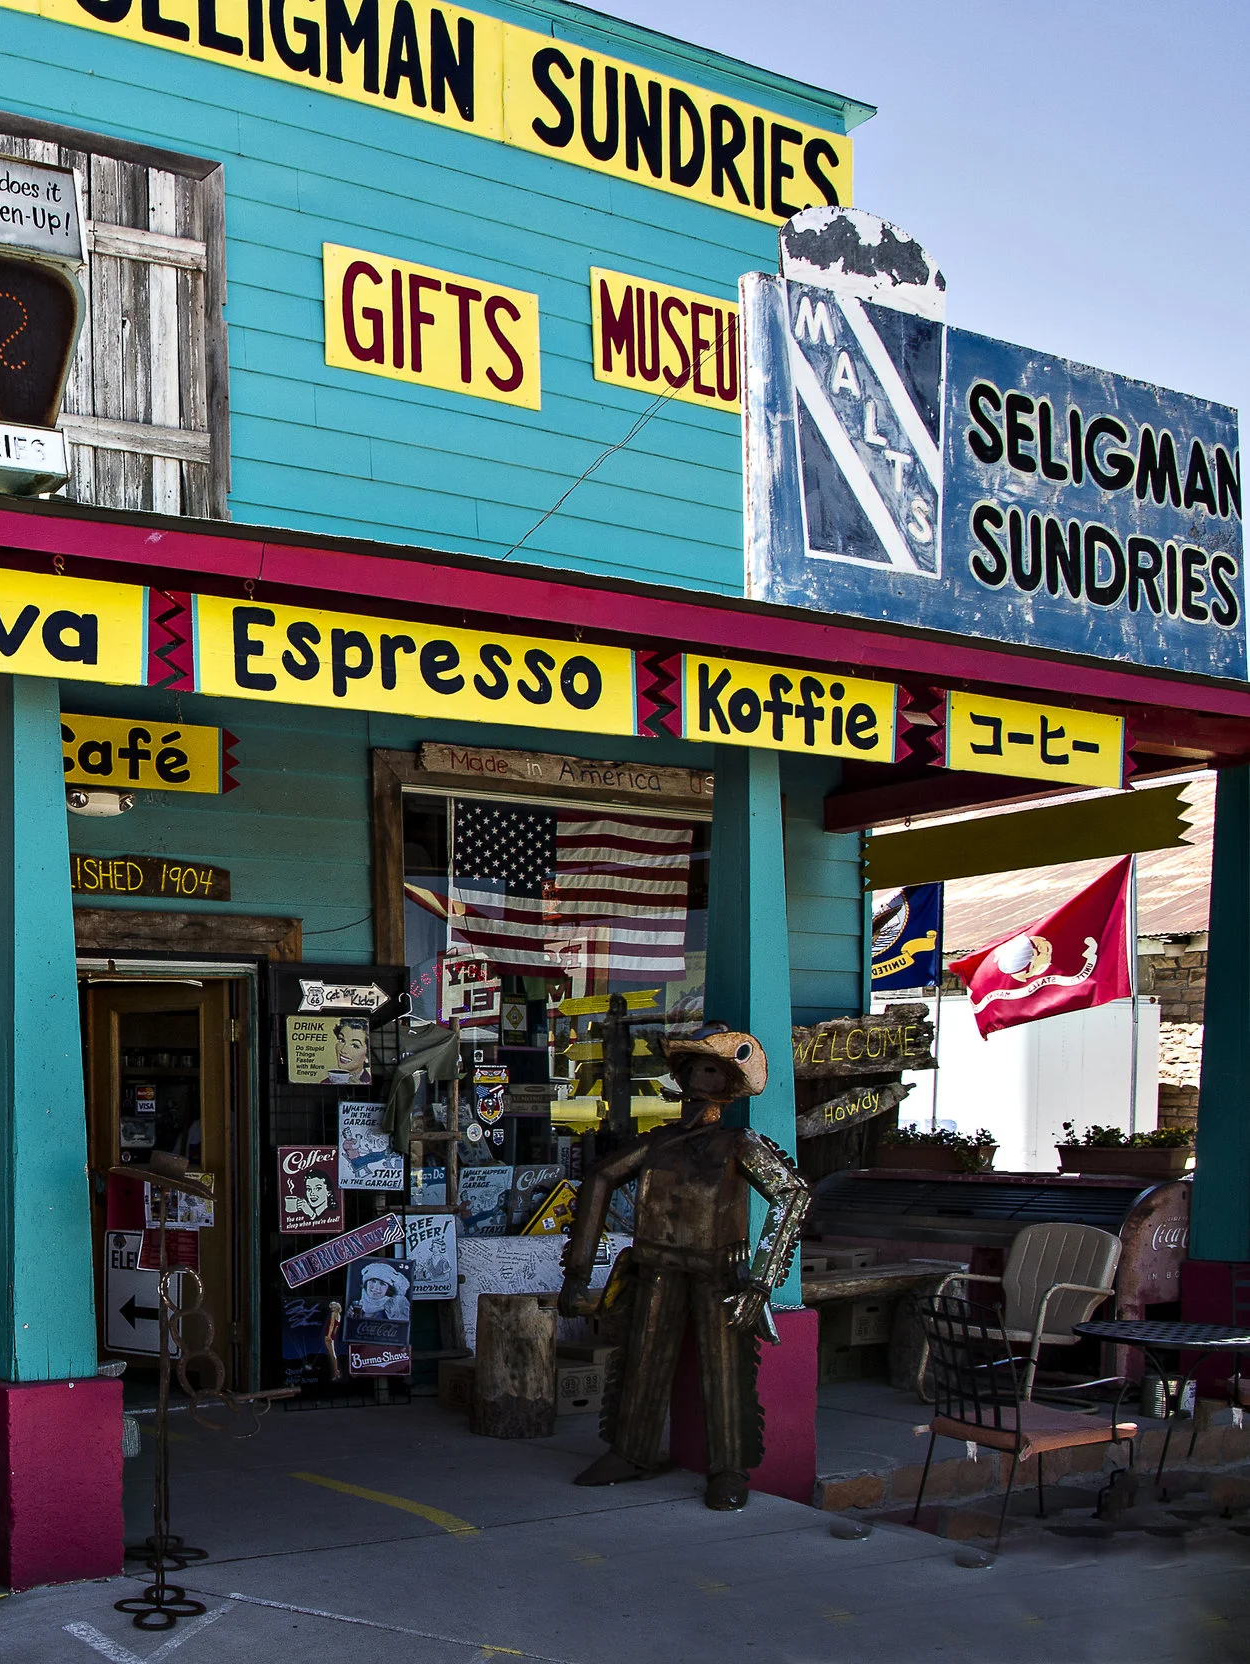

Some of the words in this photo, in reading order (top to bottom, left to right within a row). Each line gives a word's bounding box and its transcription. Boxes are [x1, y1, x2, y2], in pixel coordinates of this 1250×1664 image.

[531, 48, 841, 219] SUNDRIES
[45, 180, 62, 203] it
[341, 260, 524, 393] GIFTS
[600, 280, 741, 403] MUSEU
[795, 295, 934, 544] MALTS
[967, 380, 1242, 521] SELIGMAN
[970, 502, 1240, 629] SUNDRIES
[232, 605, 602, 710] Espresso
[698, 667, 879, 751] Koffie
[970, 711, 1101, 767] コーヒー
[450, 750, 509, 775] Made
[526, 758, 542, 777] in
[559, 760, 661, 792] America
[161, 864, 213, 895] 1904
[291, 1032, 328, 1042] COFFEE
[293, 1022, 325, 1031] DRINK
[793, 1024, 918, 1064] WELCOME
[138, 1102, 155, 1111] VISA
[341, 1104, 365, 1114] WHAT
[824, 1091, 880, 1125] Howdy
[282, 1149, 337, 1175] Coffee!
[372, 1169, 403, 1179] STAYS
[463, 1169, 481, 1180] WHAT
[365, 1179, 402, 1188] GARAGE!
[517, 1167, 560, 1191] Coffee!
[407, 1221, 452, 1252] BEER!
[286, 1231, 366, 1284] AMERICAN
[351, 1351, 410, 1369] Burma-Shave
